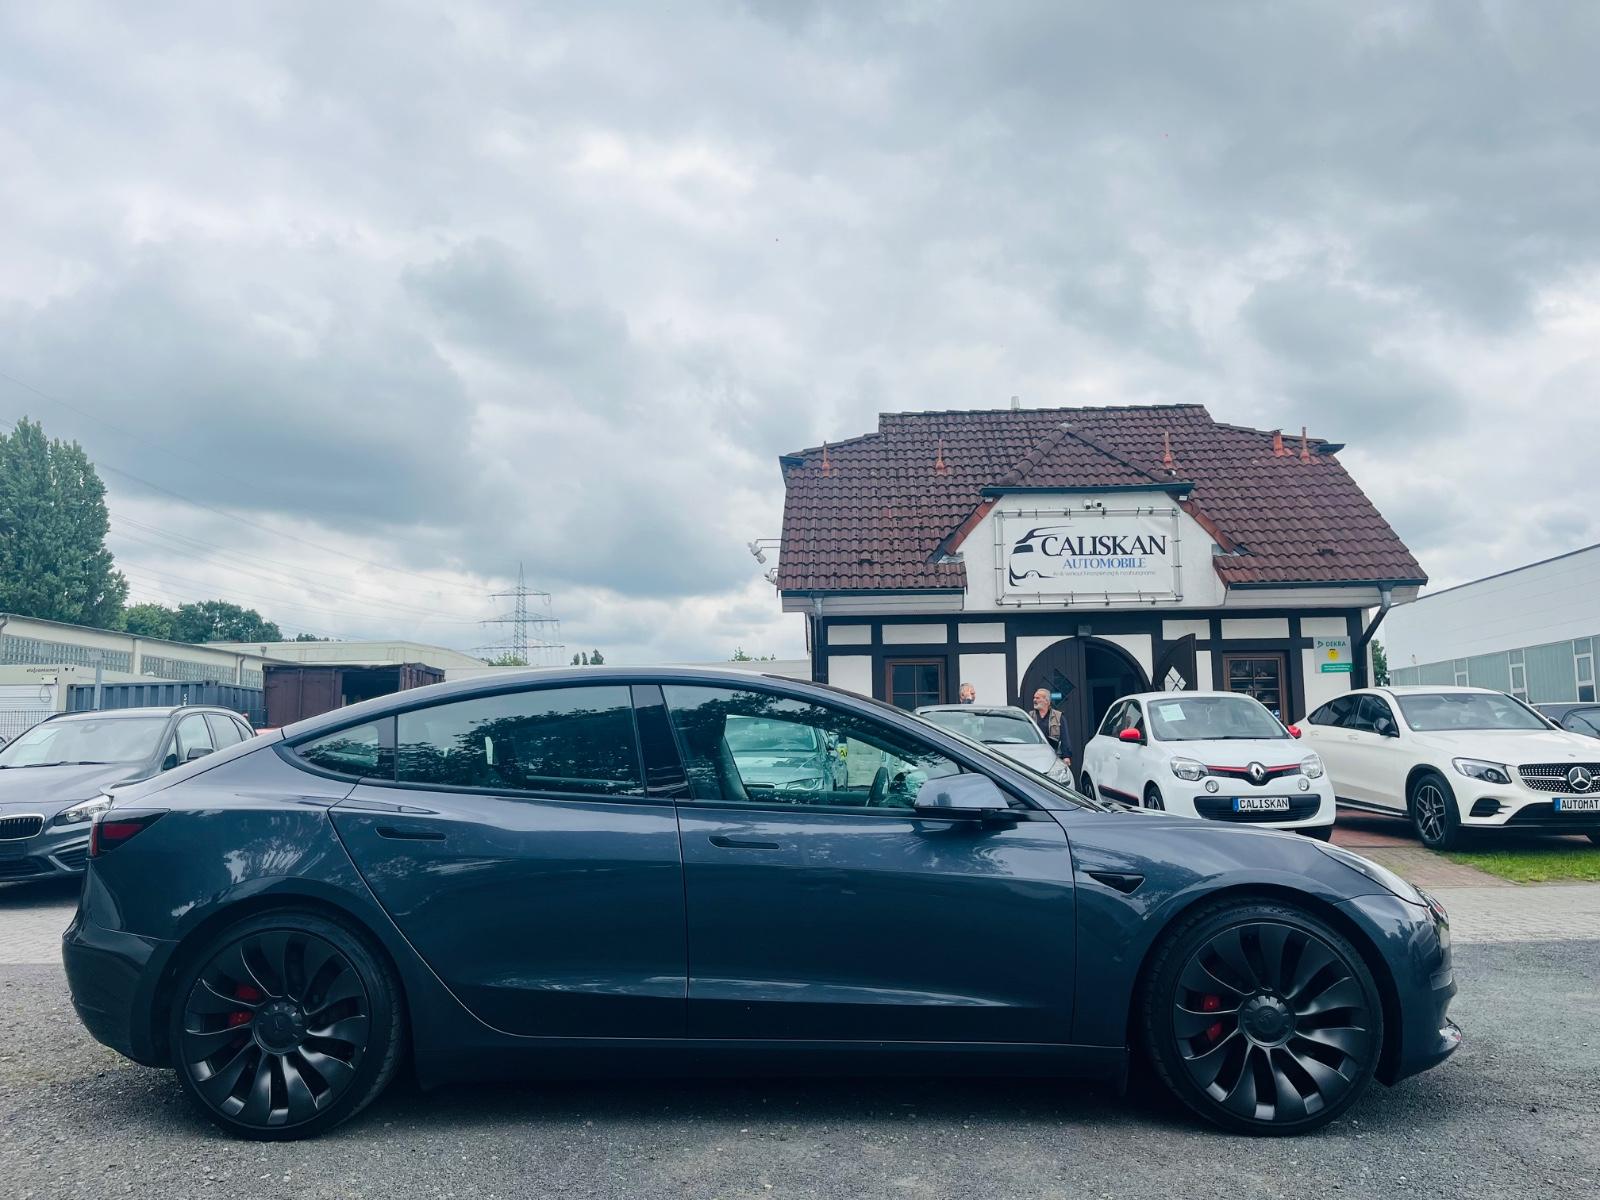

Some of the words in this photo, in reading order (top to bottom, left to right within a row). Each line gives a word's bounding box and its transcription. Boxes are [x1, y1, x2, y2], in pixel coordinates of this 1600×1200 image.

[1041, 535, 1167, 556] CALISKAN
[1062, 557, 1147, 569] AUTOMOBILE
[1240, 799, 1288, 809] CALISKAN
